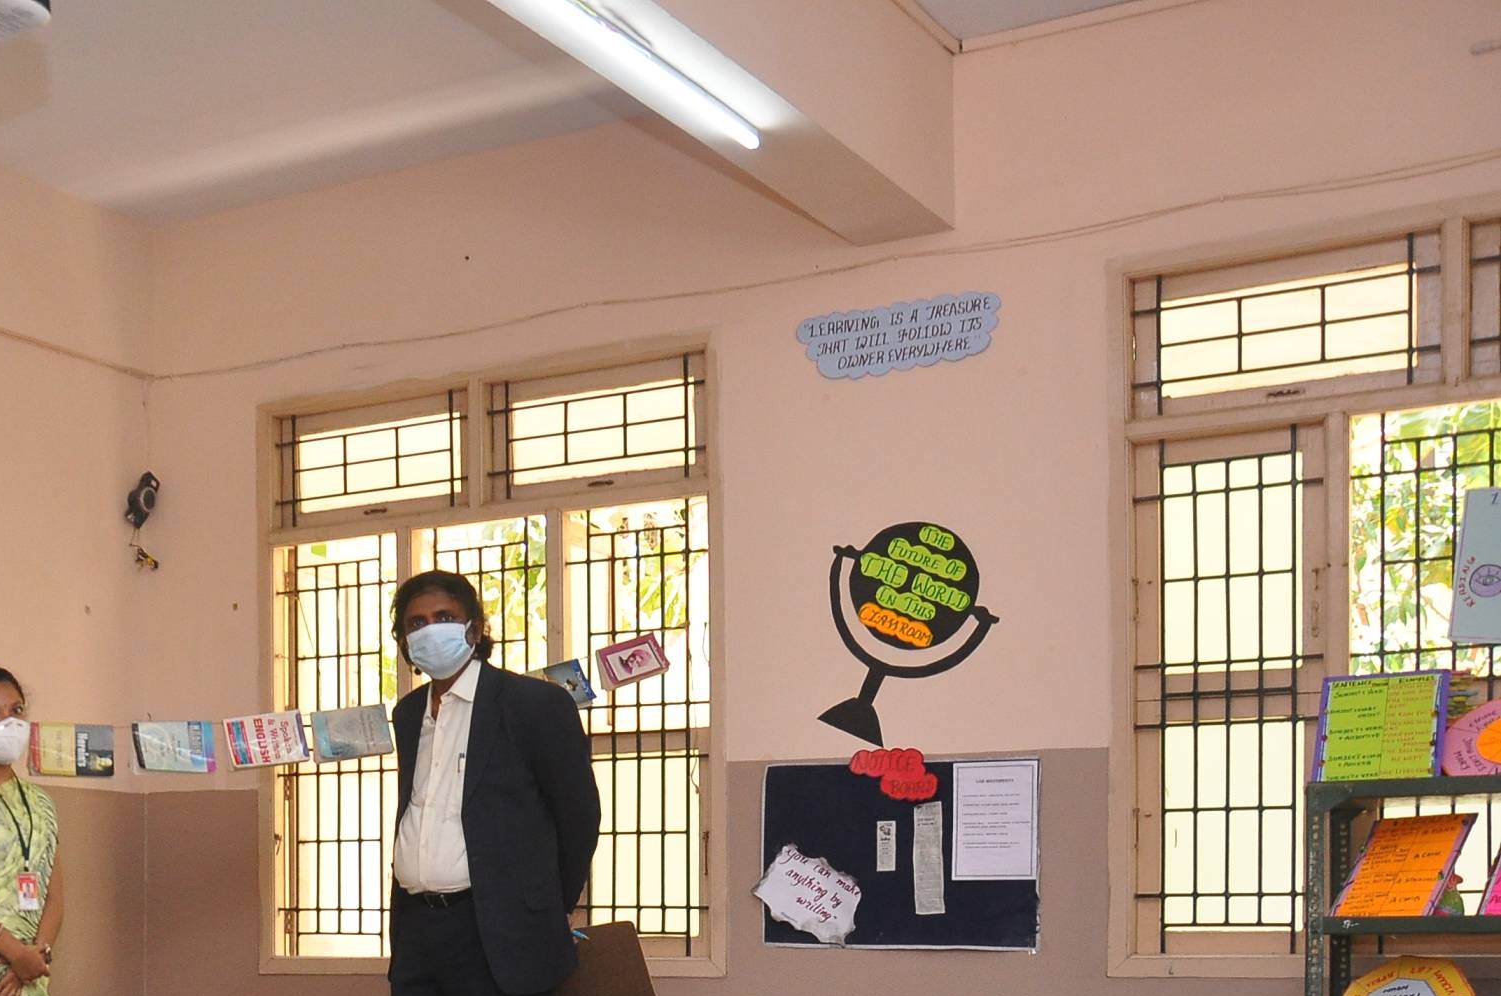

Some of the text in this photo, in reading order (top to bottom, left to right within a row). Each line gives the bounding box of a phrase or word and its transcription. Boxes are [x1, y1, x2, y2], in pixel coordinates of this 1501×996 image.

[890, 312, 904, 326] IS
[910, 309, 919, 324] A
[926, 296, 990, 321] TREASURE
[817, 317, 982, 357] THAT WILL FOLLOW ITS
[837, 350, 884, 370] OWNER
[922, 527, 951, 547] THE
[890, 539, 964, 576] FUTURE OF
[862, 556, 970, 610] THE WORLD
[878, 588, 935, 621] IN THIS
[859, 605, 933, 646] CLASSROOM
[253, 718, 271, 763] ENGLISH
[279, 720, 292, 754] Spoken
[785, 868, 843, 909] anything by
[812, 864, 831, 878] can
[835, 878, 861, 897] make
